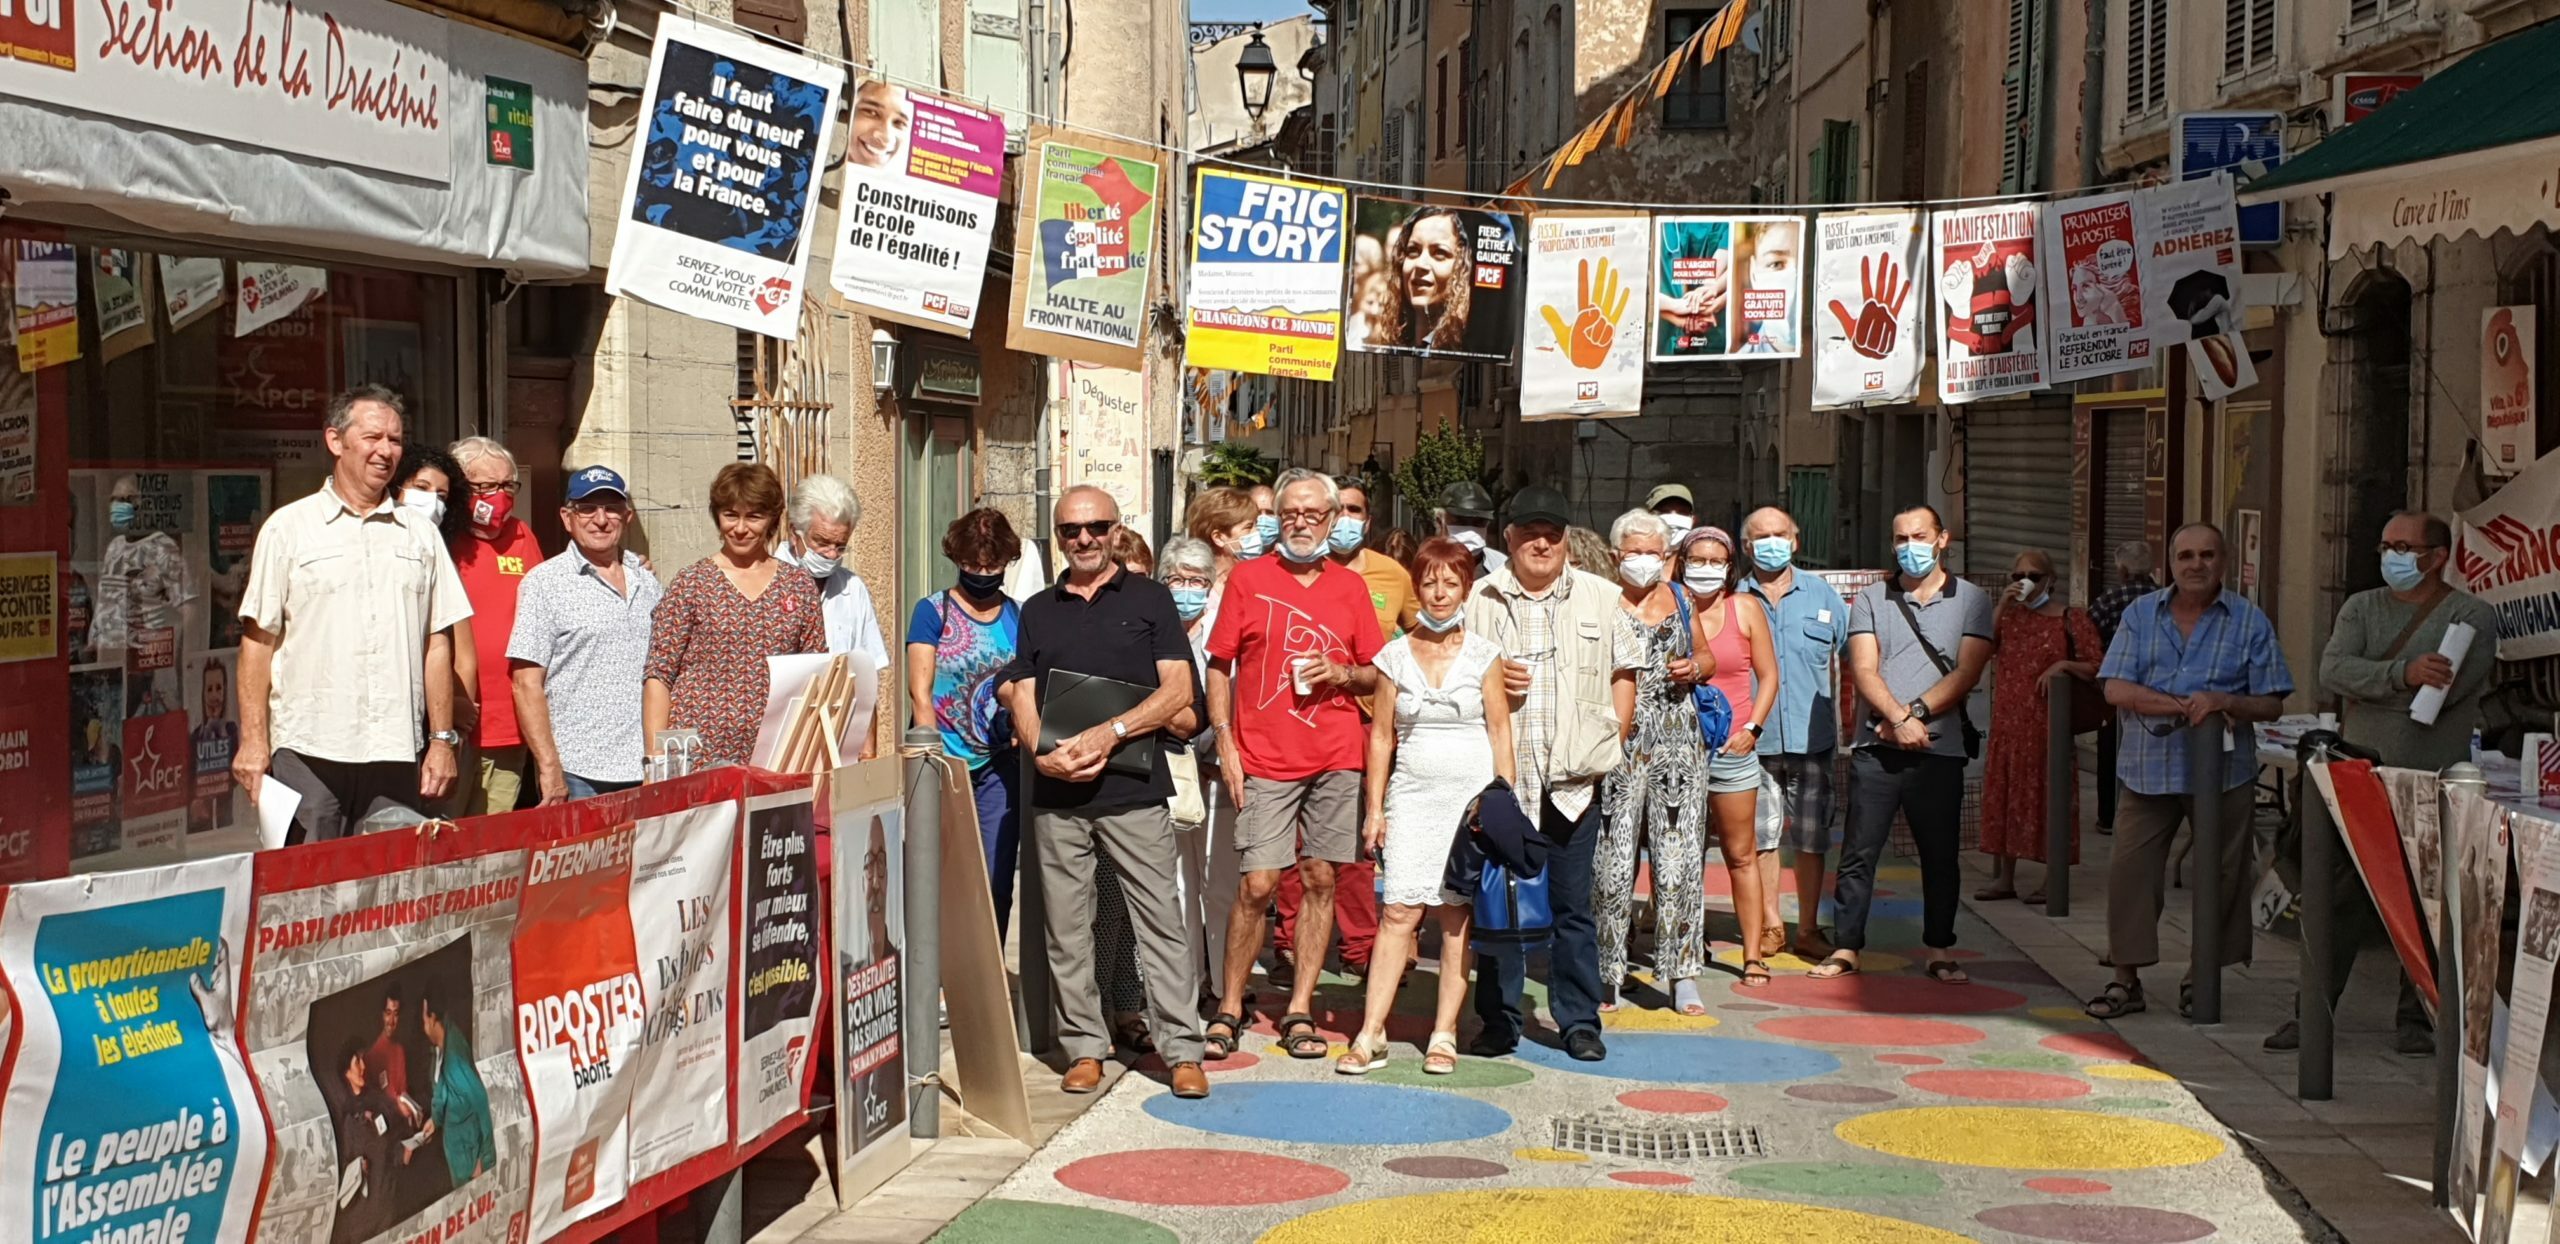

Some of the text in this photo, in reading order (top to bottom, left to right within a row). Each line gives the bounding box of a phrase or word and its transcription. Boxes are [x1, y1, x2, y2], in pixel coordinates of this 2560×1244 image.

[234, 0, 267, 88] de
[279, 0, 312, 99] la
[324, 12, 438, 130] Dracénie
[711, 75, 774, 114] Il faut
[674, 91, 804, 149] faire du neuf
[682, 123, 782, 168] pour vous
[1048, 146, 1071, 158] Parti
[692, 152, 764, 188] et pour
[1046, 159, 1104, 178] communiste
[1046, 168, 1083, 183] français
[673, 169, 770, 216] la France.
[1238, 181, 1339, 229] FRIC
[857, 182, 979, 230] Construisons
[1064, 202, 1121, 220] liberté
[2064, 202, 2129, 231] PRIVATISER
[2393, 197, 2426, 228] Cave
[2427, 192, 2437, 223] à
[854, 205, 916, 236] l'école
[1478, 225, 1502, 239] FIERS
[1537, 223, 1564, 240] ASSEZ
[1825, 220, 1849, 239] ASSEZ
[1943, 210, 2034, 244] MANIFESTATION
[850, 226, 873, 250] de
[877, 232, 949, 269] l'égalité
[1065, 225, 1124, 248] égalité
[1198, 213, 1337, 263] STORY
[1477, 235, 1514, 253] D'ÊTRE À
[1538, 233, 1616, 254] PROPOSONS ENSEMBLE
[1826, 235, 1863, 251] RIPOSTONS
[2066, 232, 2081, 248] LA
[676, 254, 756, 286] SERVEZ-VOUS
[1060, 250, 1146, 269] fraternité
[1476, 252, 1514, 266] GAUCHE.
[1673, 259, 1715, 269] DE L'ARGENT
[692, 271, 747, 297] DU VOTE
[1477, 268, 1501, 284] PCF
[668, 280, 752, 311] COMMUNISTE
[751, 282, 790, 306] PCF
[925, 293, 947, 309] PCF
[1046, 292, 1125, 319] HALTE AU
[1029, 308, 1135, 341] FRONT NATIONAL
[1193, 308, 1335, 336] CHANGEONS CE MONDE
[1745, 309, 1784, 319] 100% SÉCU
[1269, 343, 1293, 355] Parti
[2059, 329, 2103, 343] Partout en
[2059, 337, 2117, 357] REFERENDUM
[2130, 341, 2149, 355] PCF
[1268, 355, 1332, 369] communiste
[1947, 349, 2038, 380] AU TRAITÉ D'AUSTÉRITÉ
[2059, 349, 2122, 370] LE 3 OCTOBRE
[1579, 382, 1598, 397] PCF
[1866, 373, 1883, 388] PCF
[268, 388, 314, 409] PCF
[1082, 379, 1138, 415] Déguster
[1085, 460, 1122, 477] place
[135, 473, 169, 492] TAXER
[139, 494, 182, 511] REVENUS
[144, 512, 179, 530] CAPITAL
[497, 555, 524, 572] PCF
[0, 574, 50, 596] SERVICES
[0, 595, 51, 618] CONTRE
[11, 620, 34, 637] FRIC
[197, 739, 230, 759] UTILES
[156, 765, 183, 791] PCF
[761, 827, 805, 861] Être plus
[766, 861, 794, 888] forts
[258, 874, 520, 954] PARTI COMMUNISTE FRANÇAIS
[677, 895, 711, 934] LES
[771, 889, 808, 915] mieux
[752, 918, 809, 953] se défendre,
[43, 936, 211, 996] La proportionnelle
[765, 956, 811, 996] possible.
[847, 954, 896, 1000] DES RETRAITES
[94, 985, 159, 1025] à toutes
[518, 971, 643, 1056] RIPOSTER
[848, 979, 897, 1031] POUR VIVRE
[92, 1019, 184, 1068] les élections
[849, 1008, 898, 1057] PAS SURVIVRE
[573, 1058, 613, 1091] DROITE
[875, 1100, 888, 1124] PCF
[45, 1096, 229, 1183] Le peuple à
[41, 1151, 224, 1240] l'Assemblée
[445, 1208, 465, 1240] DE
[468, 1190, 496, 1225] LUI.
